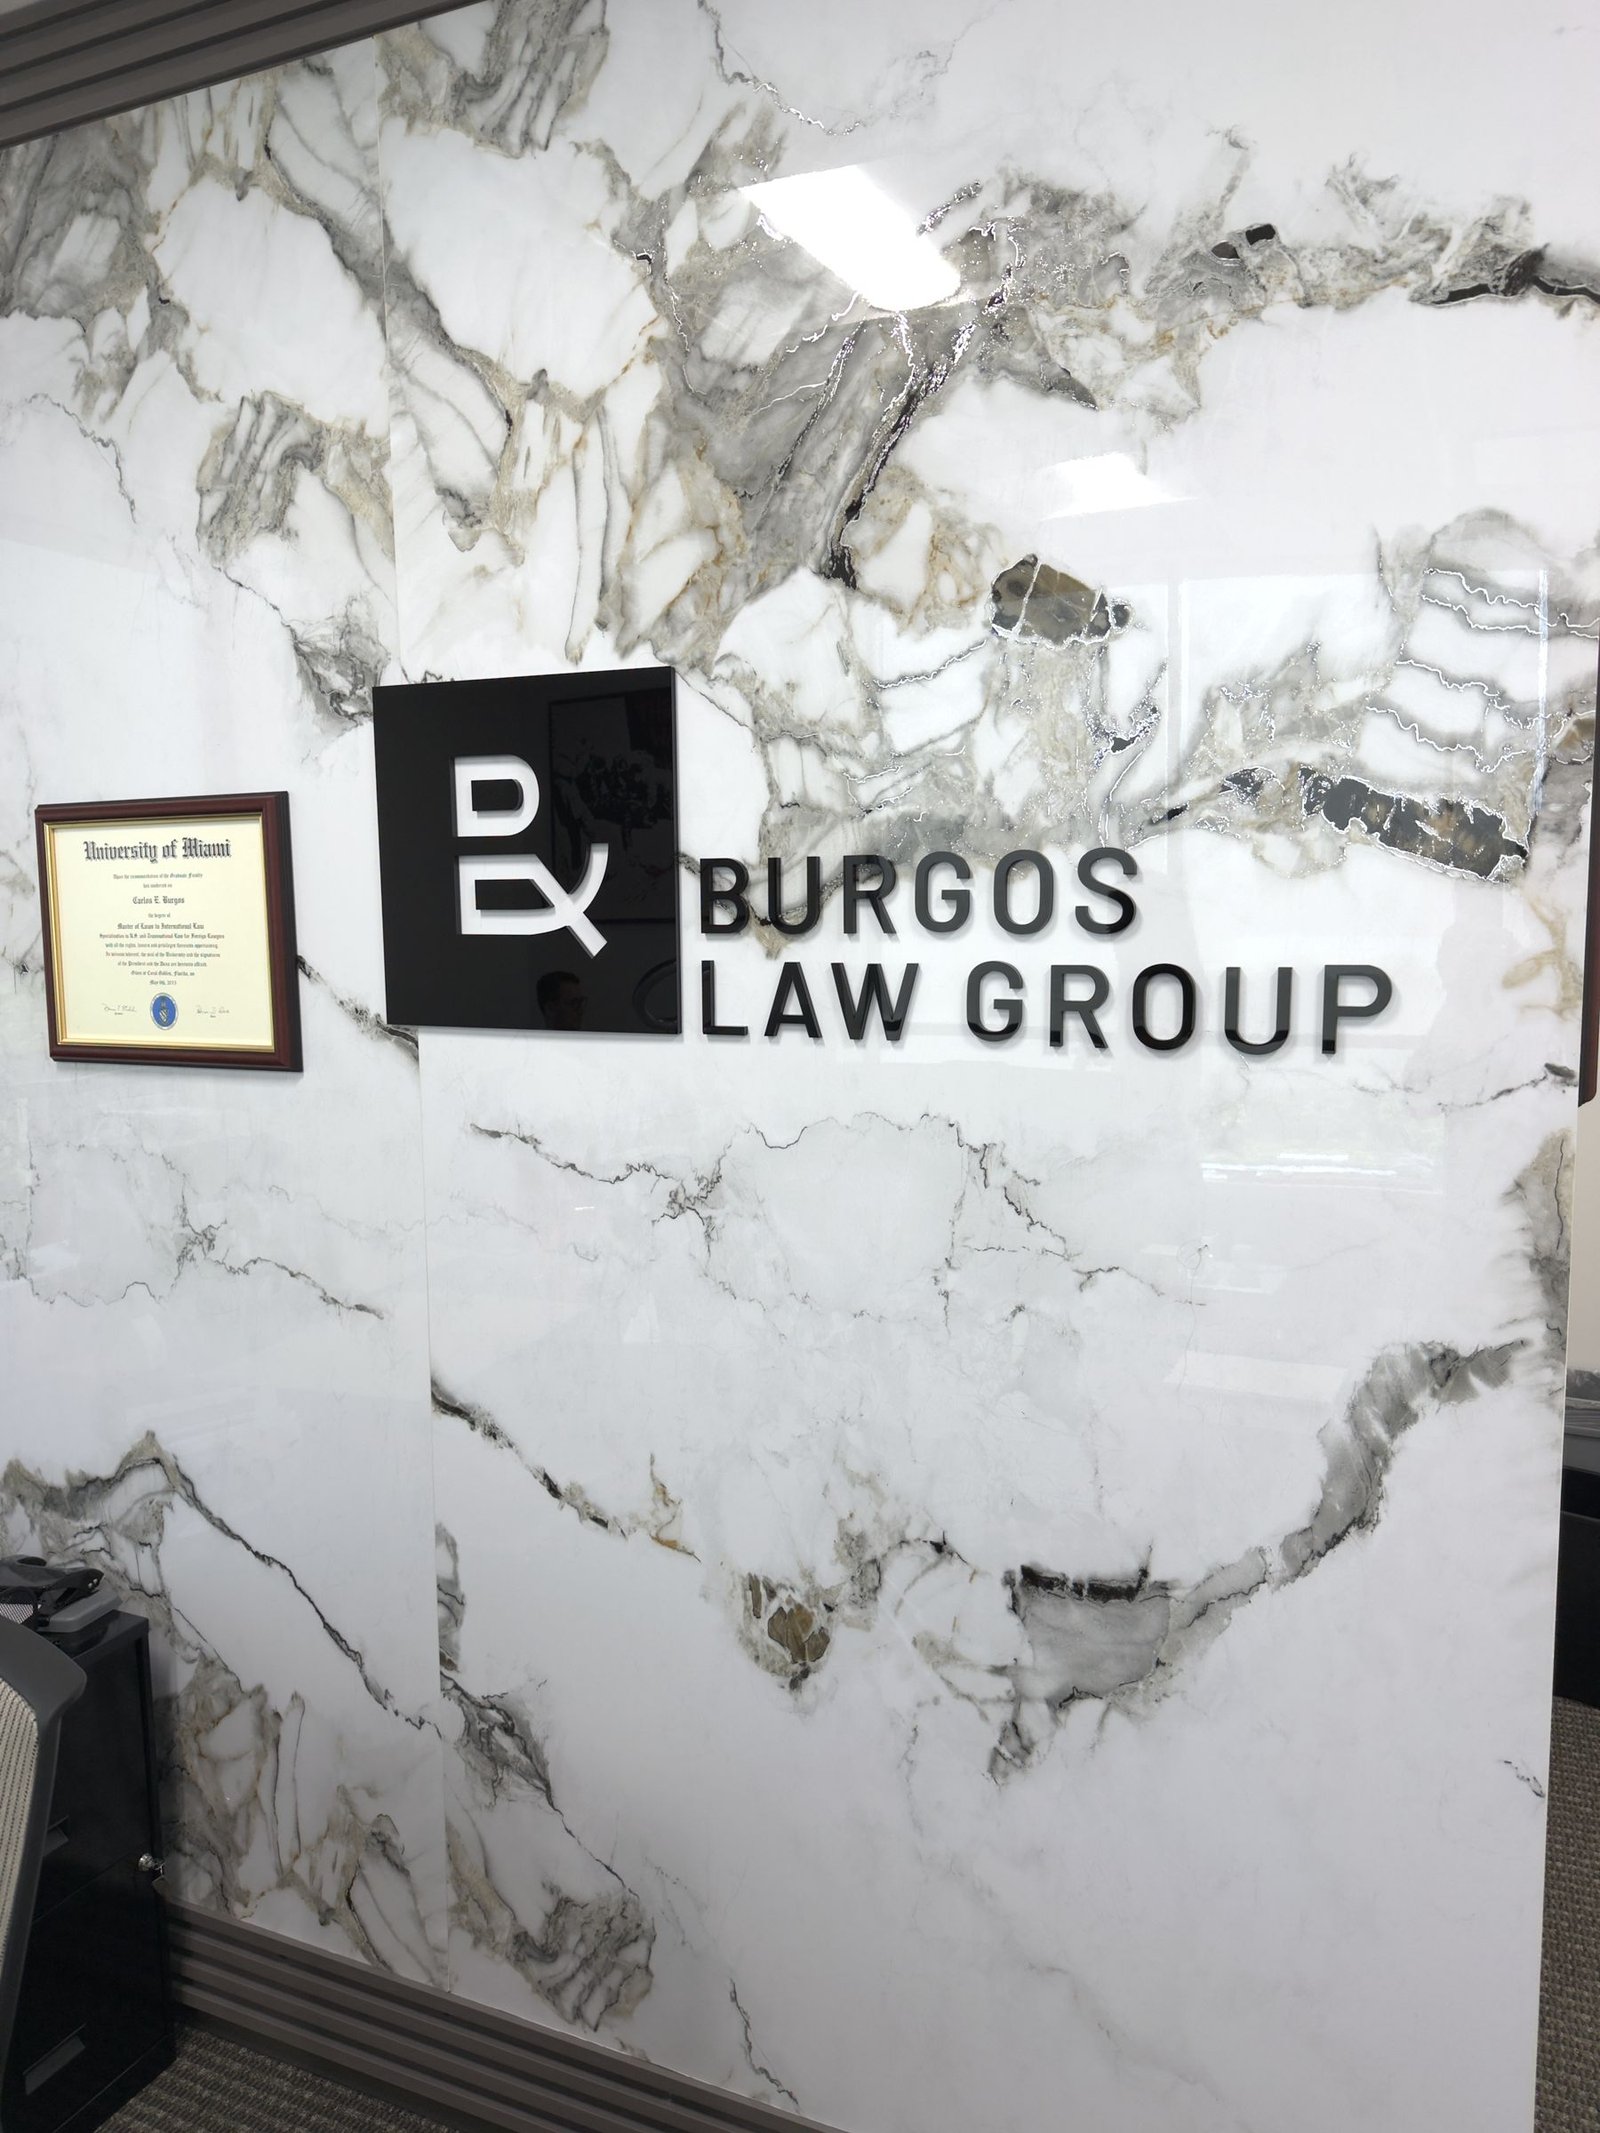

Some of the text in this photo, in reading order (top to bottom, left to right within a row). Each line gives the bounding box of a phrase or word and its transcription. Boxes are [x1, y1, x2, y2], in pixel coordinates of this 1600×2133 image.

[83, 837, 232, 864] University of Miami
[700, 847, 1138, 936] BURGOS
[701, 959, 1393, 1056] LAW GROUP
